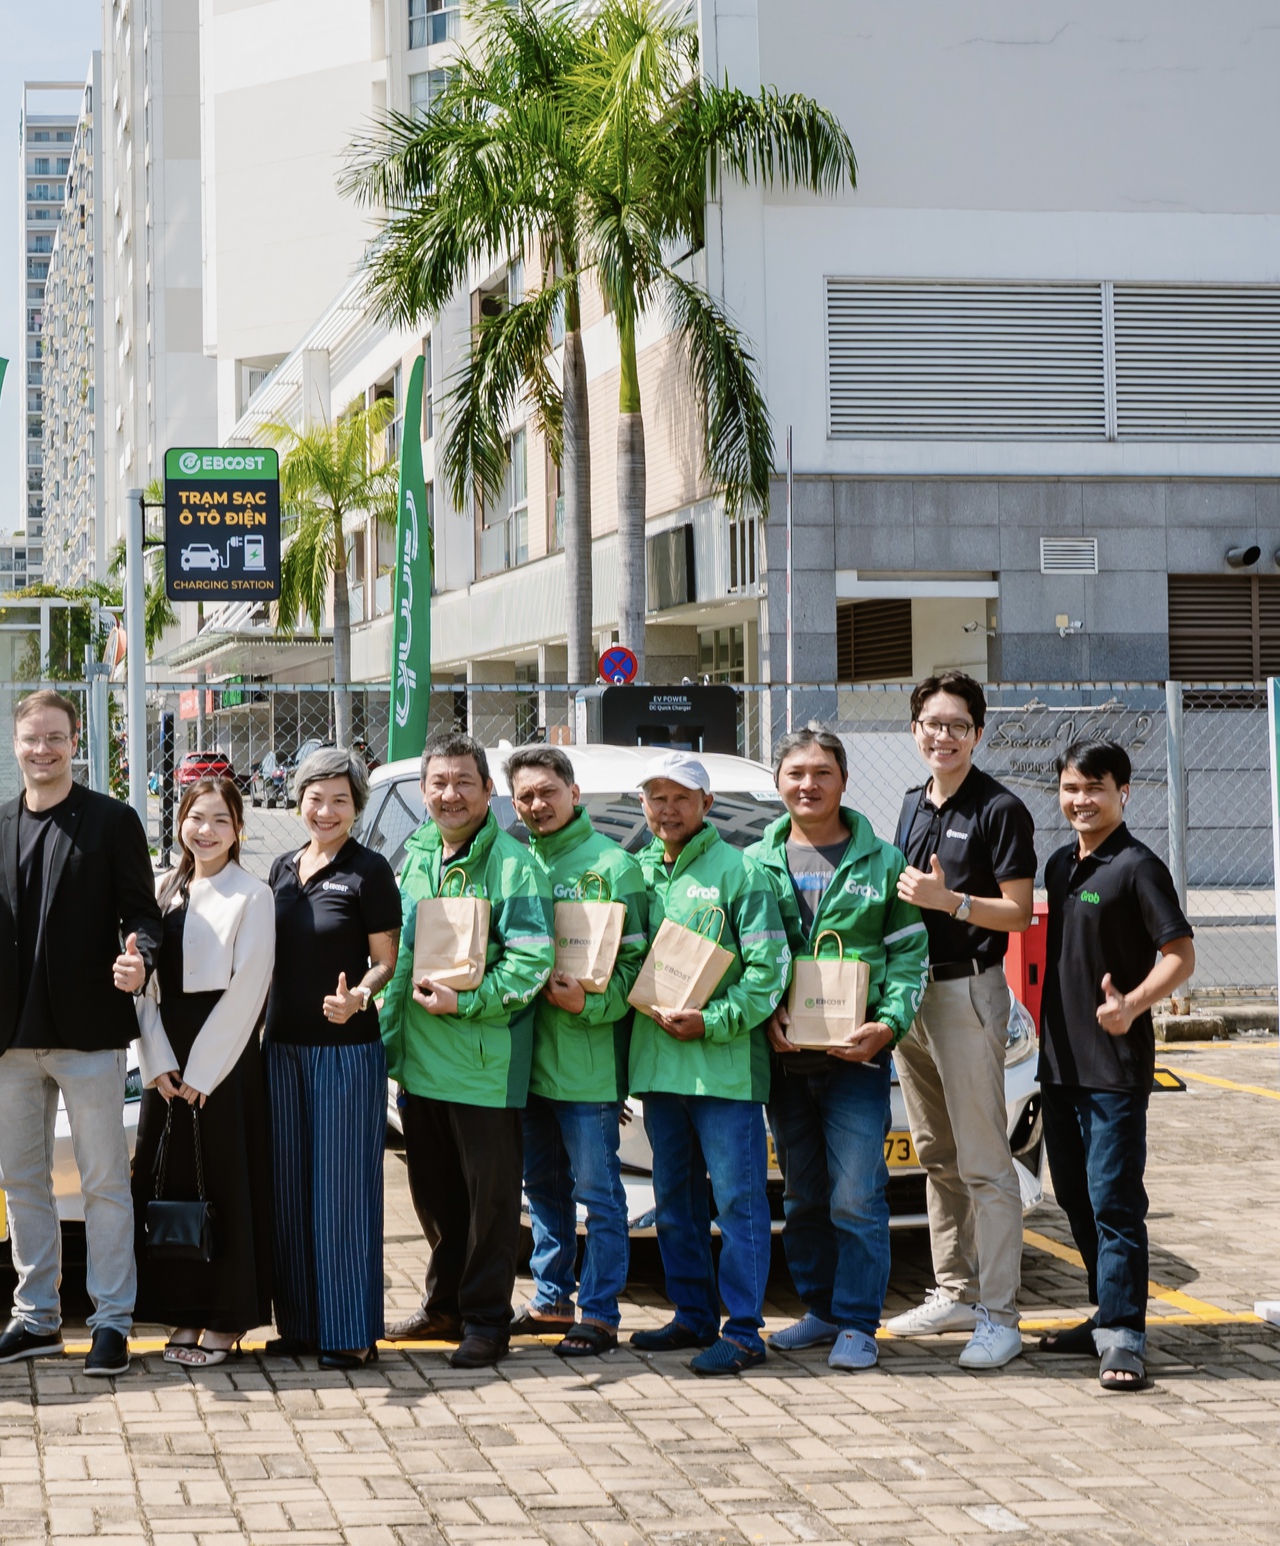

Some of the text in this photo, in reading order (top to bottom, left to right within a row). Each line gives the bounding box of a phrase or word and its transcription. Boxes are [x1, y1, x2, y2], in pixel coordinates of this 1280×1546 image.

[202, 456, 265, 470] EBOOST
[178, 491, 267, 508] TRẠM SẠC
[179, 508, 267, 529] Ô TÔ ĐIỆN
[173, 580, 274, 590] CHARGING STATION
[554, 884, 588, 899] Grab
[686, 884, 720, 900] Grab
[844, 880, 880, 899] Grab
[1080, 890, 1100, 905] Grab
[663, 964, 692, 983] EBOOST
[815, 998, 846, 1006] EBOOST
